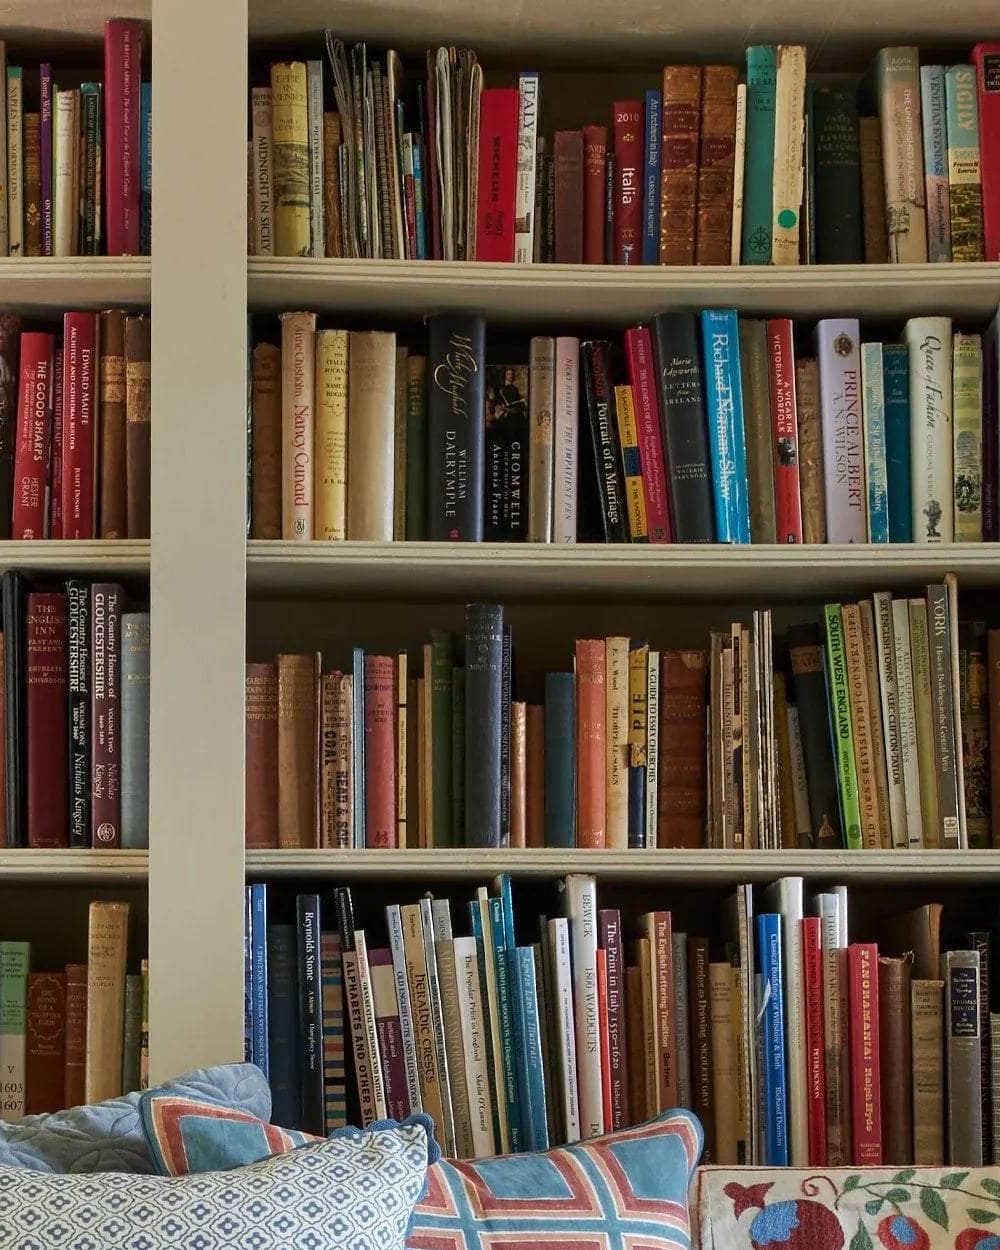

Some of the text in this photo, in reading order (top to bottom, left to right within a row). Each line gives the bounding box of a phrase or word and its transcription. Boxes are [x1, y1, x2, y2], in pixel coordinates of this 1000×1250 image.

[42, 100, 50, 122] Walks
[523, 79, 536, 128] ITALY
[955, 72, 974, 130] SICILY
[258, 136, 271, 252] MIDNIGHT IN SICILY
[622, 168, 636, 204] Italia
[34, 361, 46, 461] THE GOOD SHARPS
[81, 349, 90, 425] EDWARD MAUFE
[774, 334, 785, 432] VICTORIAN NORFOLK
[920, 336, 948, 427] Queen of Fashion
[597, 402, 611, 446] Portrait
[712, 333, 736, 500] Richard Norman Shaw
[786, 423, 792, 432] IN
[844, 370, 863, 512] PRINCE ALBERT
[445, 431, 456, 517] DALRYMPLE
[458, 449, 467, 499] WILLIAM
[511, 441, 520, 528] CROMWELL
[602, 448, 613, 461] of
[21, 476, 30, 507] GRANT
[30, 478, 39, 507] HESTER
[606, 472, 620, 525] Marriage
[69, 588, 79, 692] GLOUCESTERSHIRE
[77, 588, 88, 693] The Country Houses of
[95, 594, 104, 699] GLOUCESTERSHIRE
[106, 595, 117, 698] The Country Houses of
[649, 703, 656, 714] TO
[828, 615, 849, 739] SOUTH WEST ENGLAND
[880, 598, 901, 786] SIX ENGLISH TOWNS ALEC CLIFTON-TAYLOR
[303, 912, 314, 981] Reynolds Stone
[607, 922, 617, 944] The
[607, 947, 618, 973] Print
[583, 894, 597, 1053] BEWICK 1800 WOODCUTS
[608, 976, 618, 986] in
[608, 990, 620, 1013] Italy
[657, 921, 671, 1088] The English Lettering Tradition Bartram
[345, 960, 370, 1103] ALPHABETS AND OTHER
[861, 949, 873, 1132] PANORAMANIA! Ralph Hyde
[0, 1083, 23, 1093] 1603
[7, 1065, 15, 1073] V
[613, 1080, 621, 1111] Michael
[0, 1102, 23, 1111] 1607
